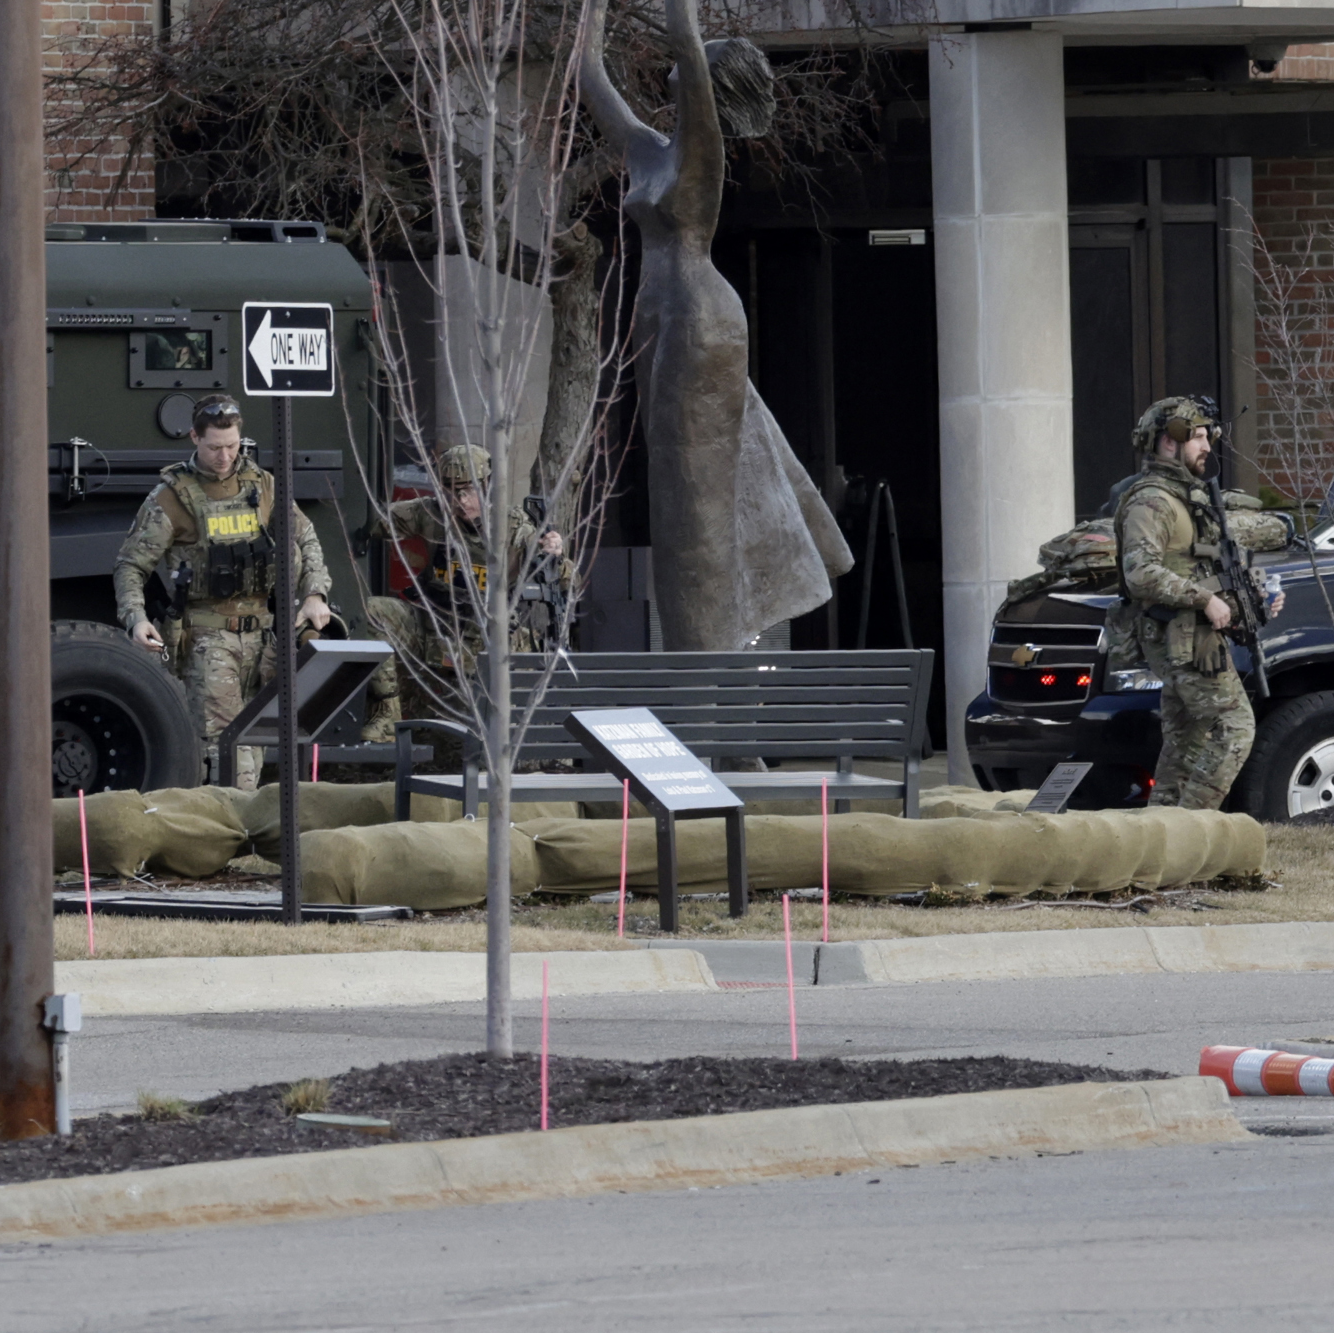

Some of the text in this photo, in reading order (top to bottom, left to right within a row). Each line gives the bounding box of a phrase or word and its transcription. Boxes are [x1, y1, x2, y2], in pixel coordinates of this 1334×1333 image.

[271, 333, 323, 365] ONE WAY
[208, 513, 260, 536] POLICE
[628, 722, 667, 738] FAMILY
[611, 744, 652, 759] GARDEN
[654, 741, 686, 756] HOPE
